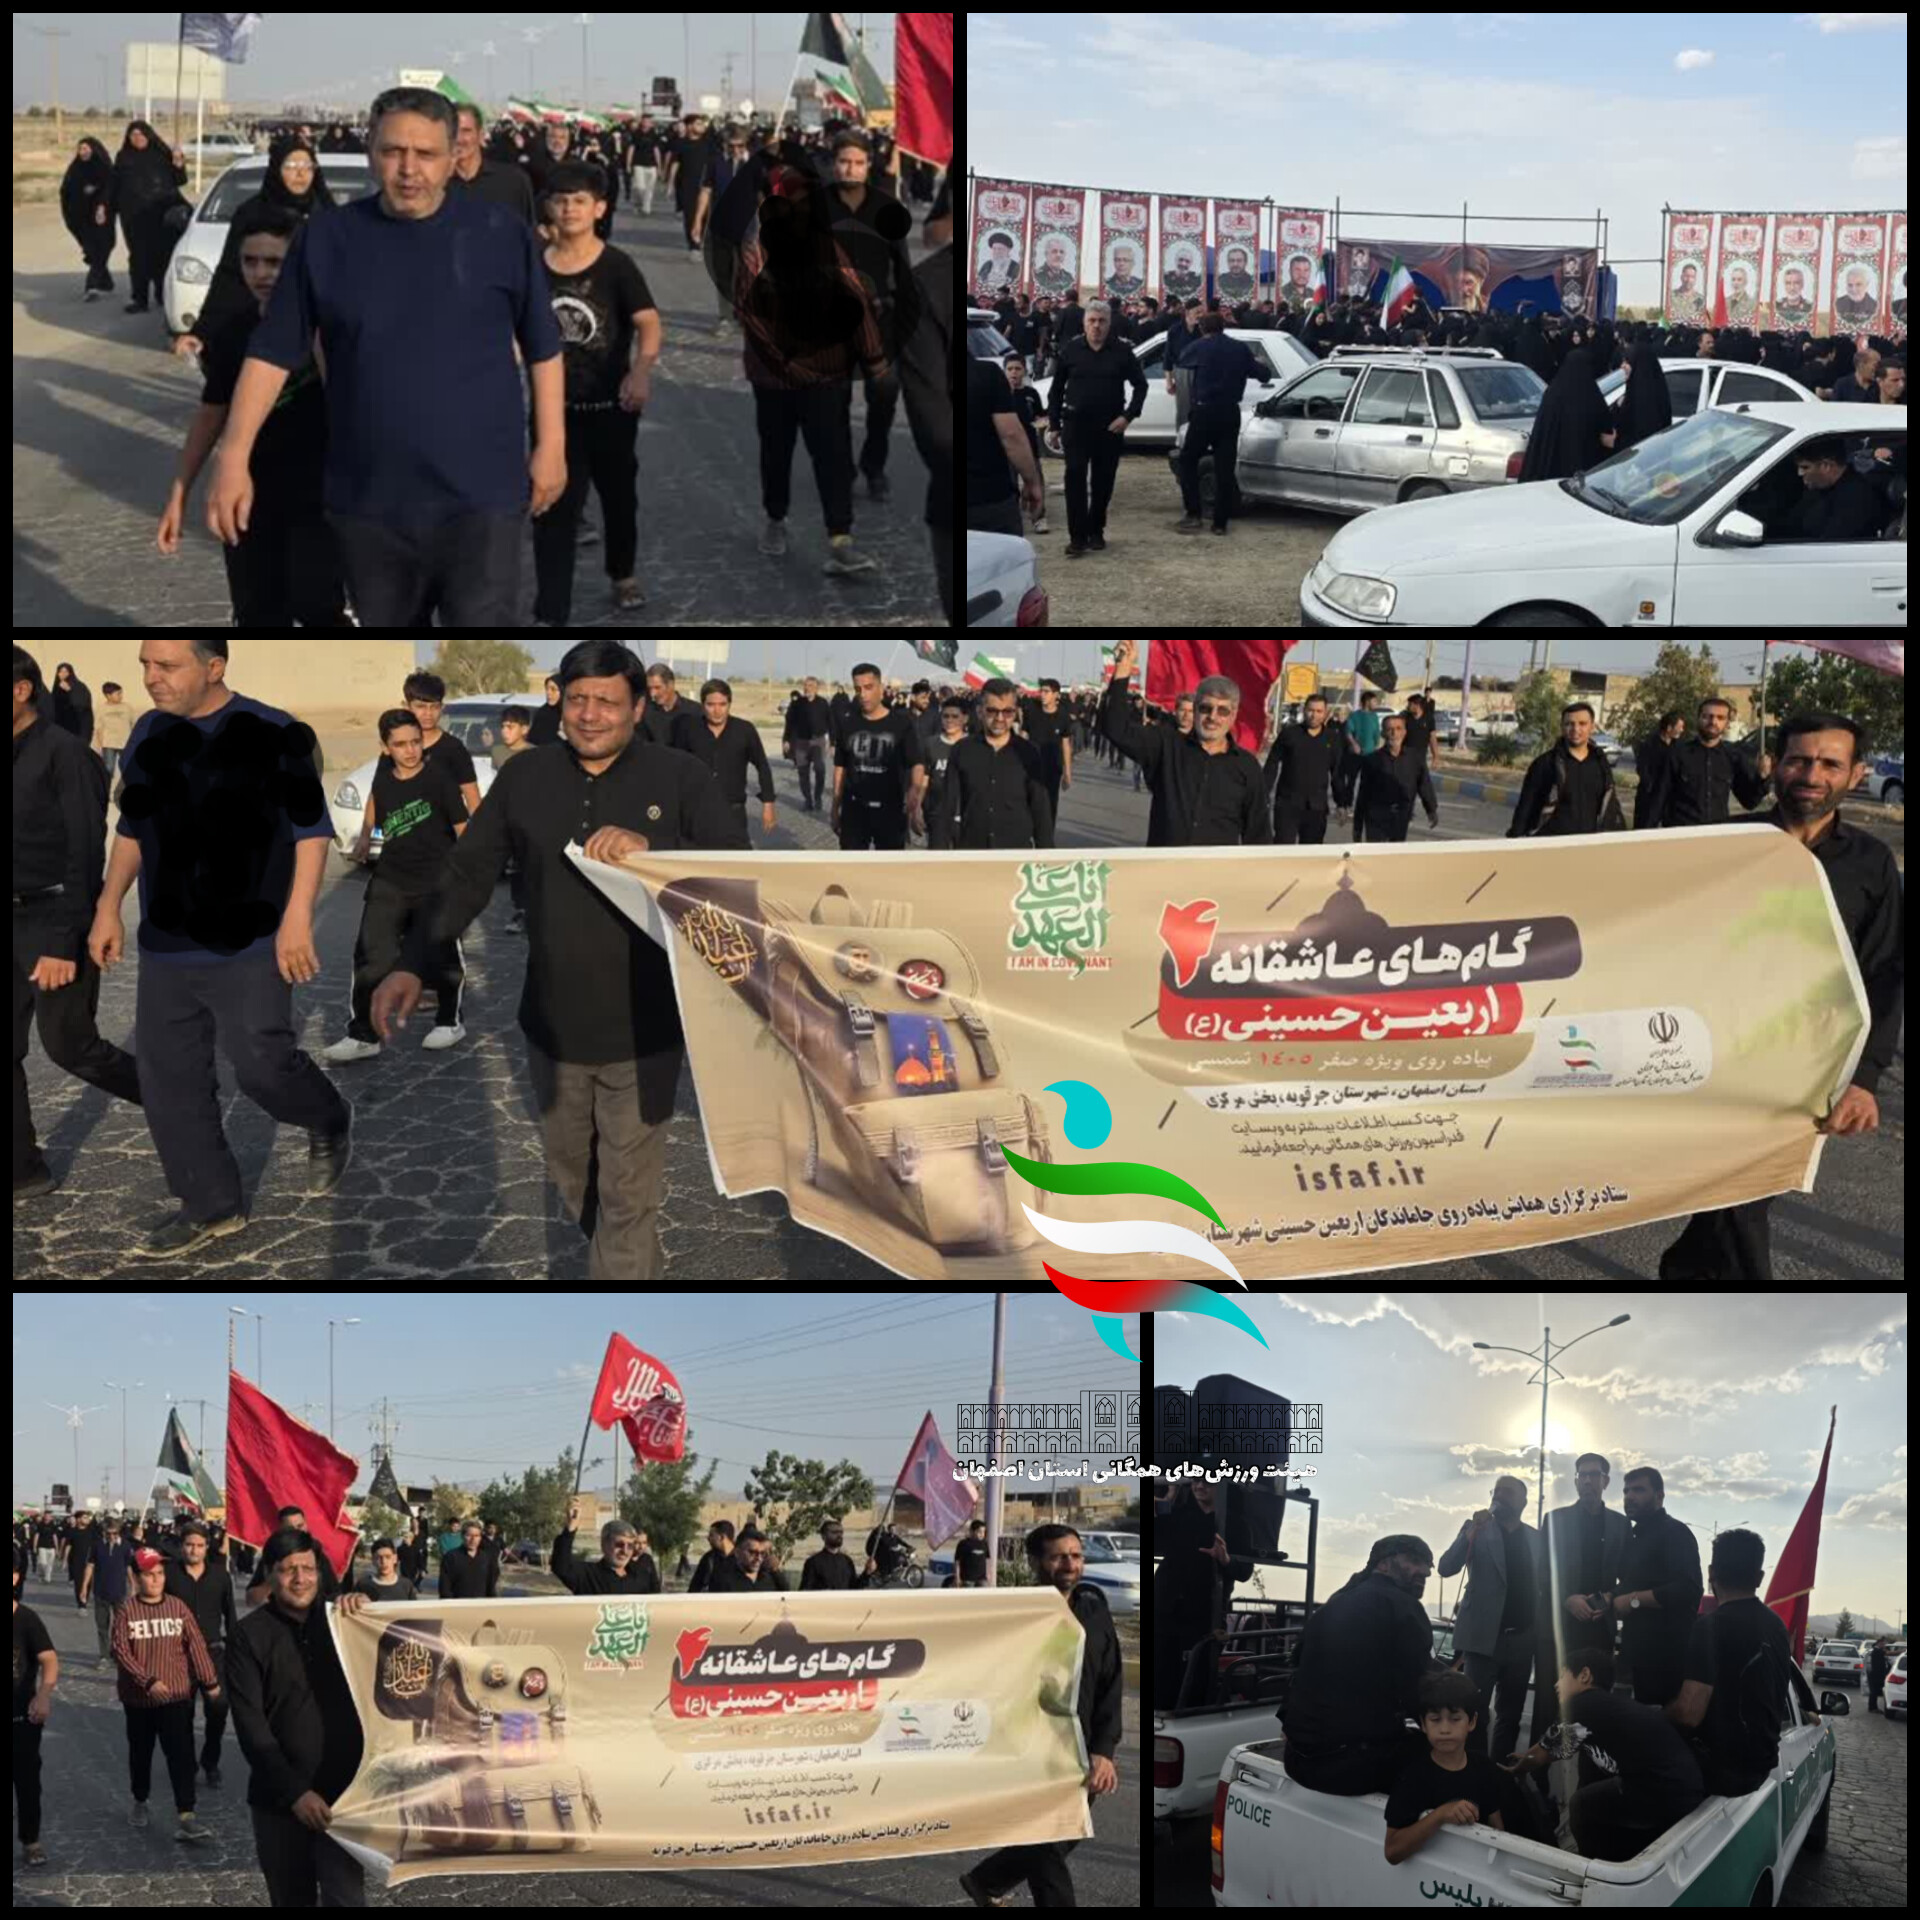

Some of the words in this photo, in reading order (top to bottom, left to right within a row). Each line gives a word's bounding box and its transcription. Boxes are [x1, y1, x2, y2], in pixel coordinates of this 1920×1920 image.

[1051, 957, 1113, 970] COVNANT
[1210, 937, 1374, 985] عاشقانه
[1361, 987, 1499, 1039] اربعین
[1318, 1051, 1359, 1071] صفر
[1364, 1053, 1403, 1071] ویژه
[1408, 1056, 1446, 1071] روی
[1453, 1050, 1492, 1069] پیاده
[1248, 1090, 1278, 1108] بخش
[1332, 1085, 1389, 1103] شهرستان
[1446, 1083, 1486, 1097] استان
[1336, 1115, 1388, 1131] اطلاعات
[1388, 1112, 1423, 1128] کسب
[1424, 1112, 1459, 1126] جهت
[1294, 1159, 1425, 1192] isfaf.ir
[1550, 1187, 1600, 1216] برگزاری
[1601, 1184, 1629, 1204] ستاد
[1501, 1194, 1546, 1220] همایش
[1202, 1219, 1263, 1246] شهرستا
[1264, 1218, 1316, 1244] حسینی
[1319, 1210, 1365, 1238] اربعین
[700, 1647, 798, 1677] عاشقانه
[782, 1680, 864, 1713] اربعین
[744, 1802, 832, 1824] isfaf.ir
[1227, 1794, 1272, 1828] POLICE
